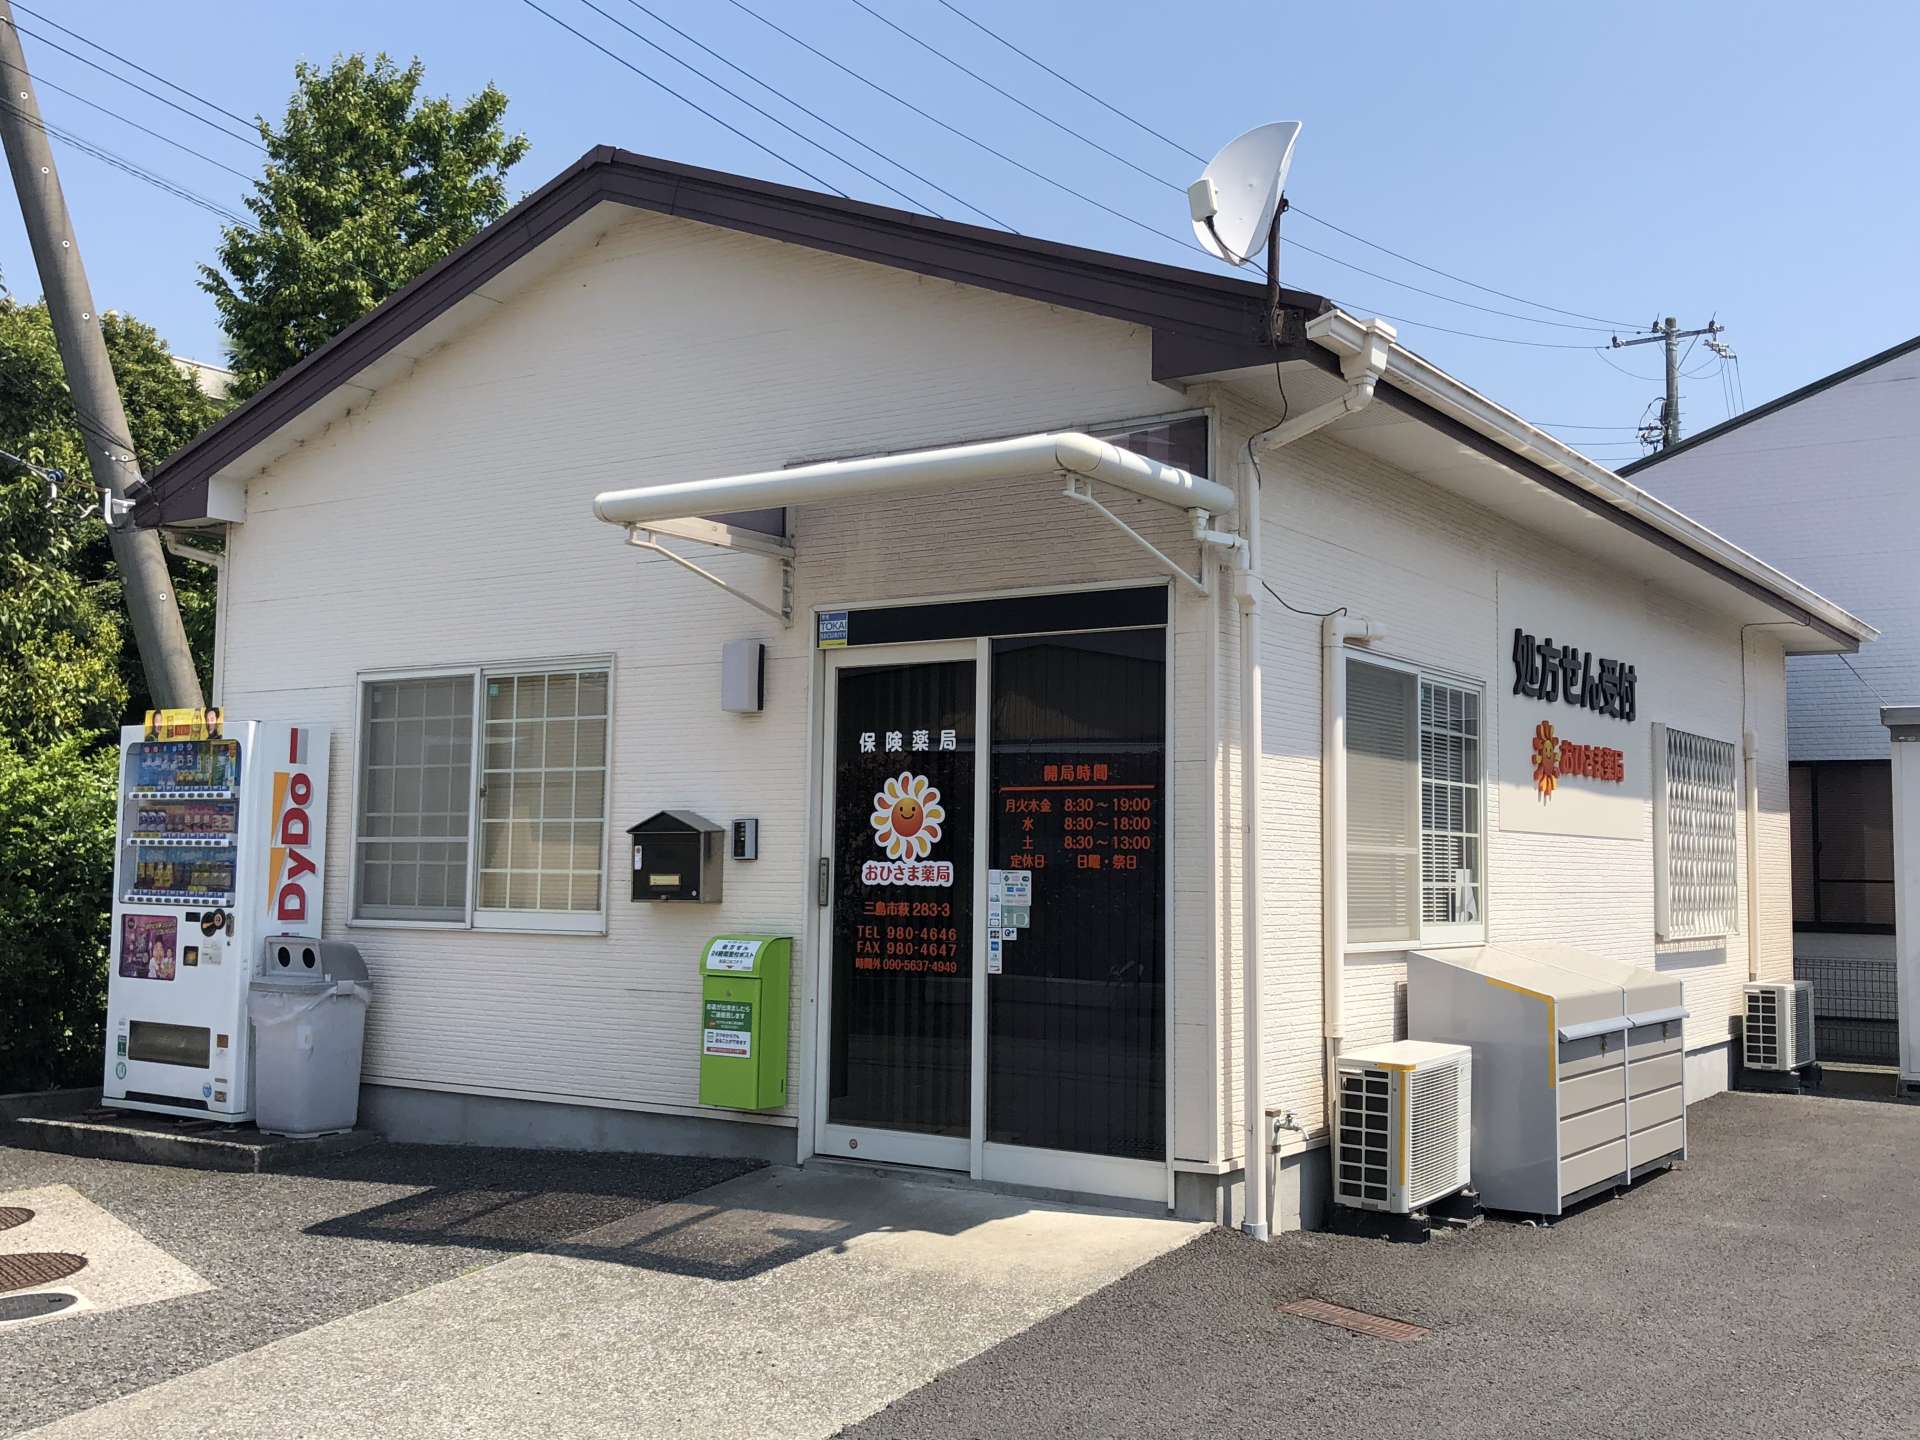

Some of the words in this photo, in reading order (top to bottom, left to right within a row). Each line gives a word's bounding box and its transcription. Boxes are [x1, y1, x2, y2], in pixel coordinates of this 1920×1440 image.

[820, 621, 847, 631] TOKAI
[1512, 628, 1637, 721] 処方せん受付
[859, 730, 957, 752] 保険薬局
[1559, 740, 1624, 782] おひさま薬局
[1043, 763, 1109, 782] 開局時間
[1005, 798, 1052, 813] 月火木金
[1022, 817, 1034, 832] 水
[1022, 835, 1034, 850] 土
[1010, 853, 1045, 869] 定休日
[1077, 853, 1137, 870] 日曜・祭日
[865, 864, 951, 883] おひさま薬局
[912, 902, 950, 917] 283-3
[1002, 911, 1030, 926] iD
[856, 925, 881, 939] TEL
[887, 926, 958, 941] 980-4646
[856, 940, 881, 954] FAX
[887, 941, 958, 957] 980-4647
[855, 957, 881, 970] 時間外
[882, 959, 958, 974] 090-5637-4949
